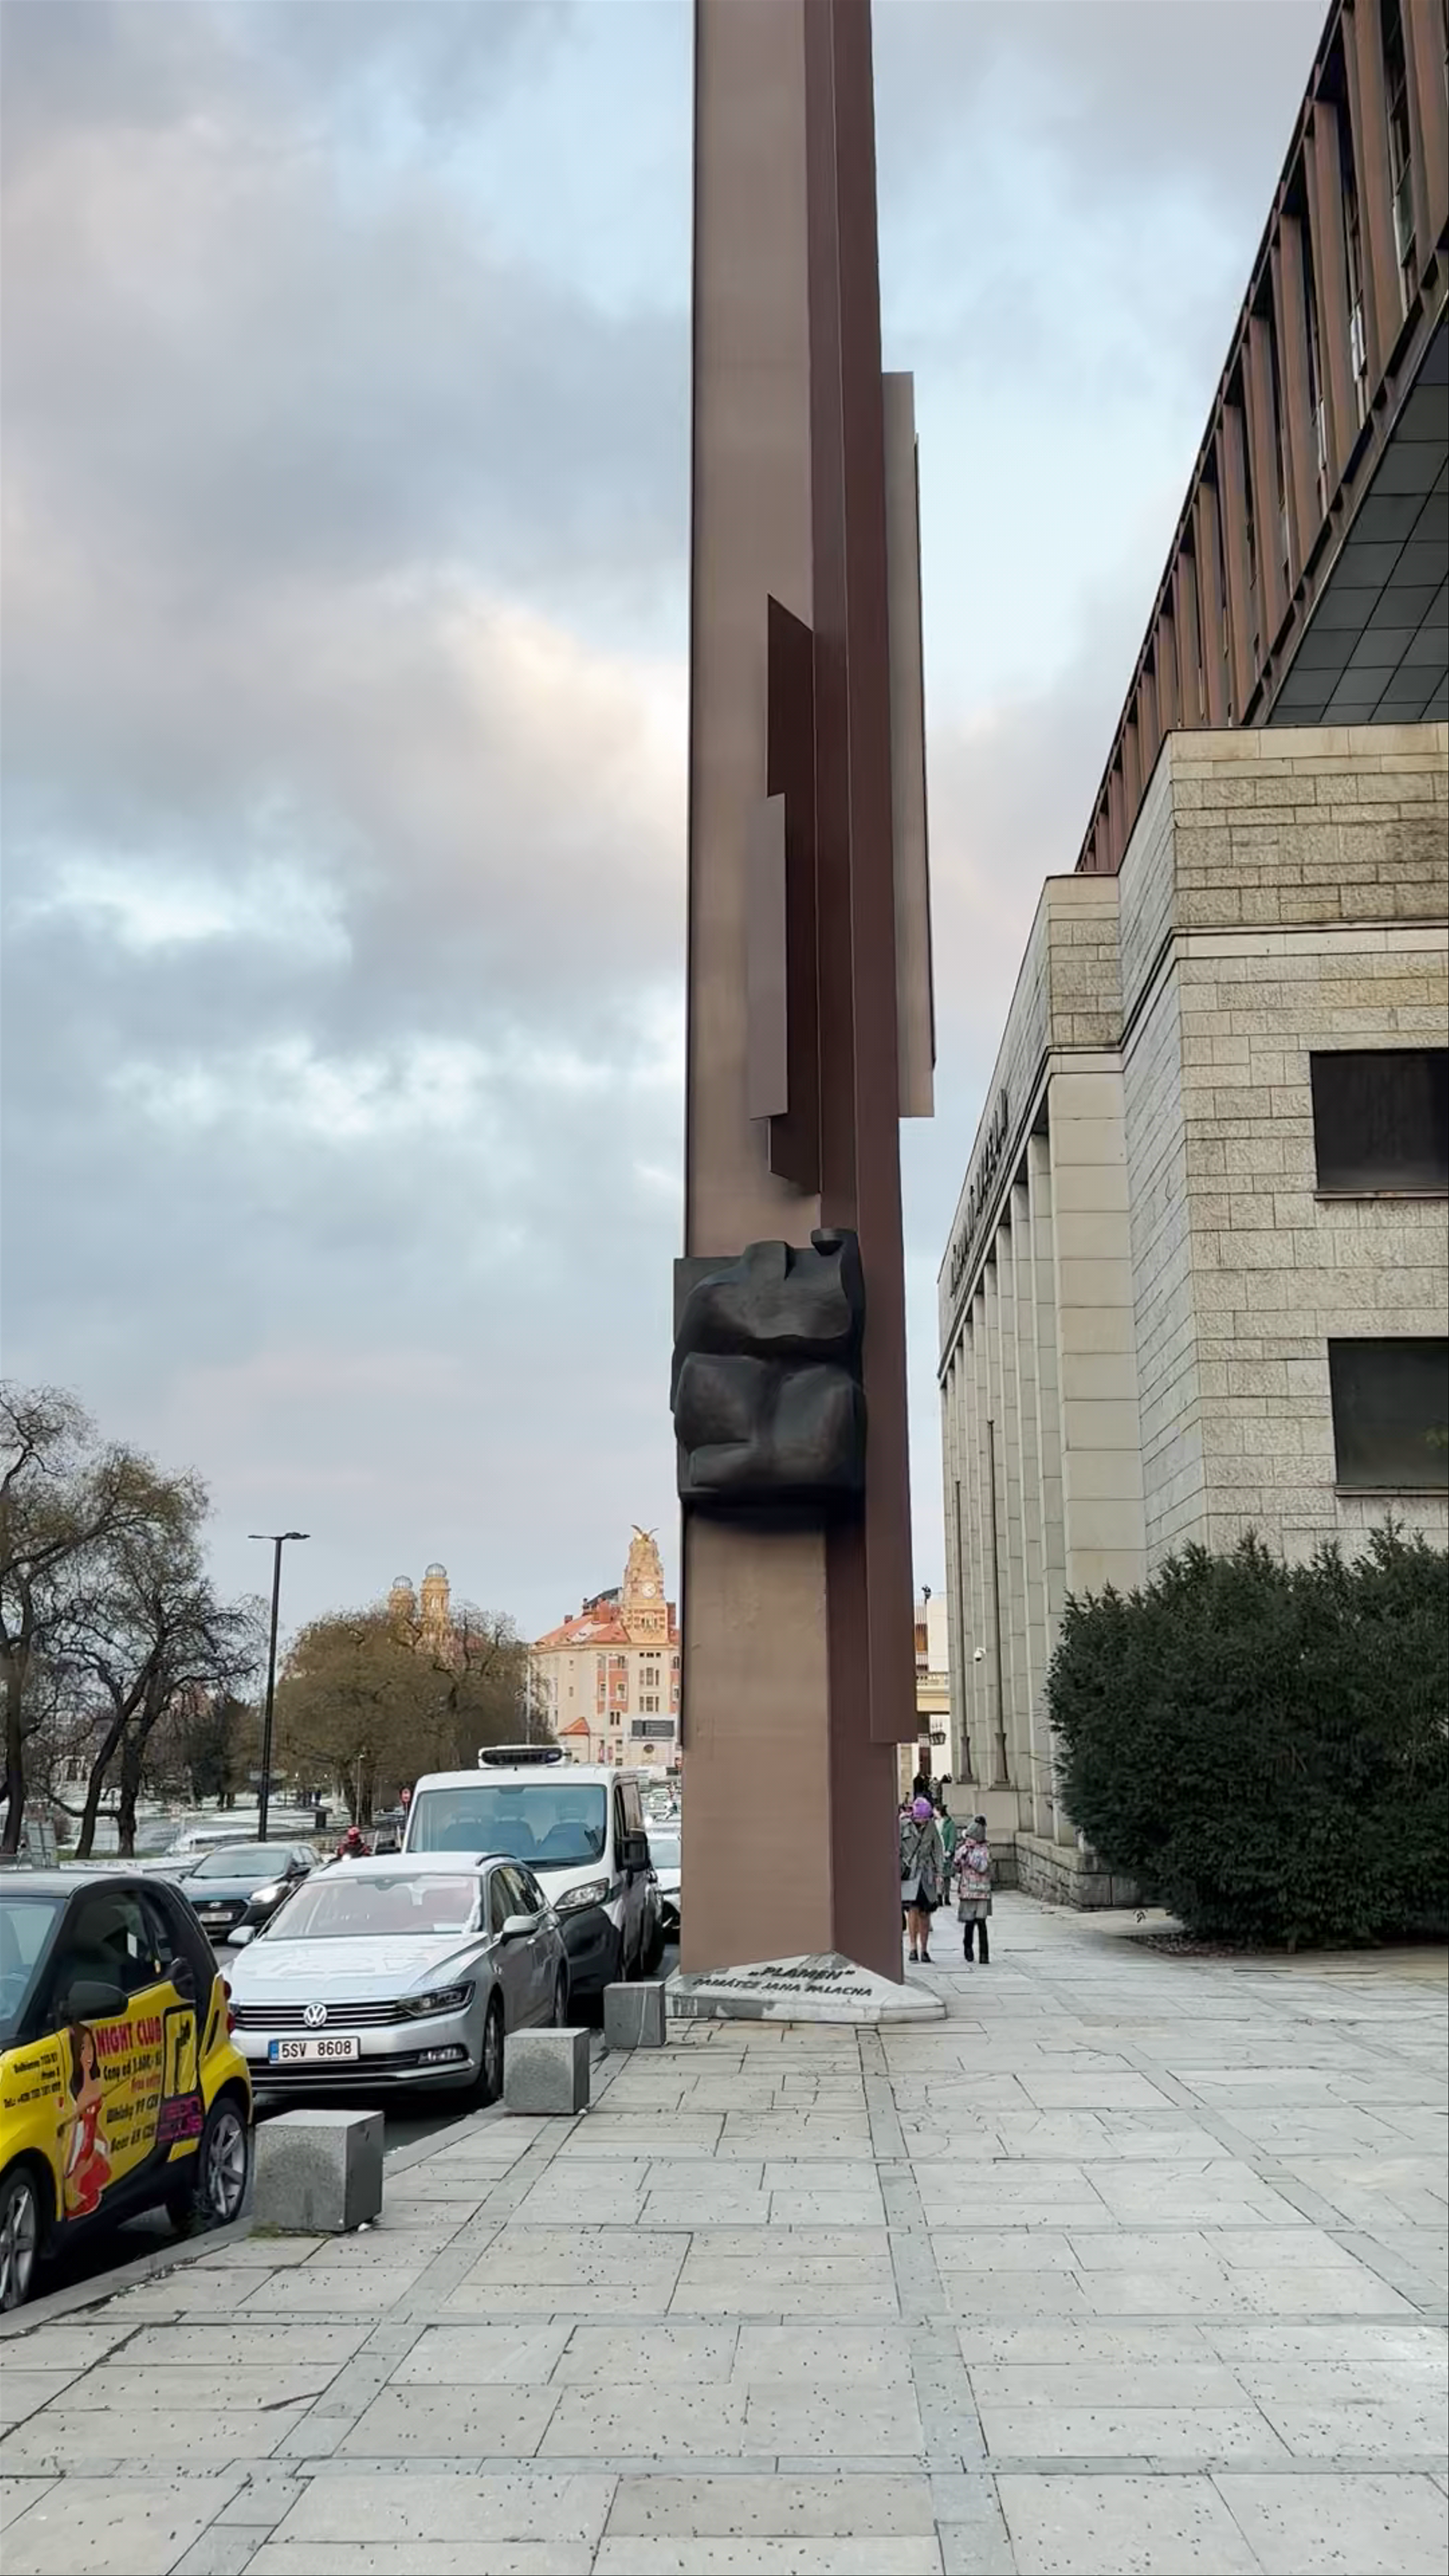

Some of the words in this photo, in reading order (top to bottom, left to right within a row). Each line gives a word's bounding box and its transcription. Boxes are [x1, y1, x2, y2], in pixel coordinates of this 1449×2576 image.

[761, 1982, 801, 1992] JANA
[95, 2021, 133, 2057] NIGHT
[281, 2042, 306, 2058] 5SV
[317, 2040, 351, 2056] 8608
